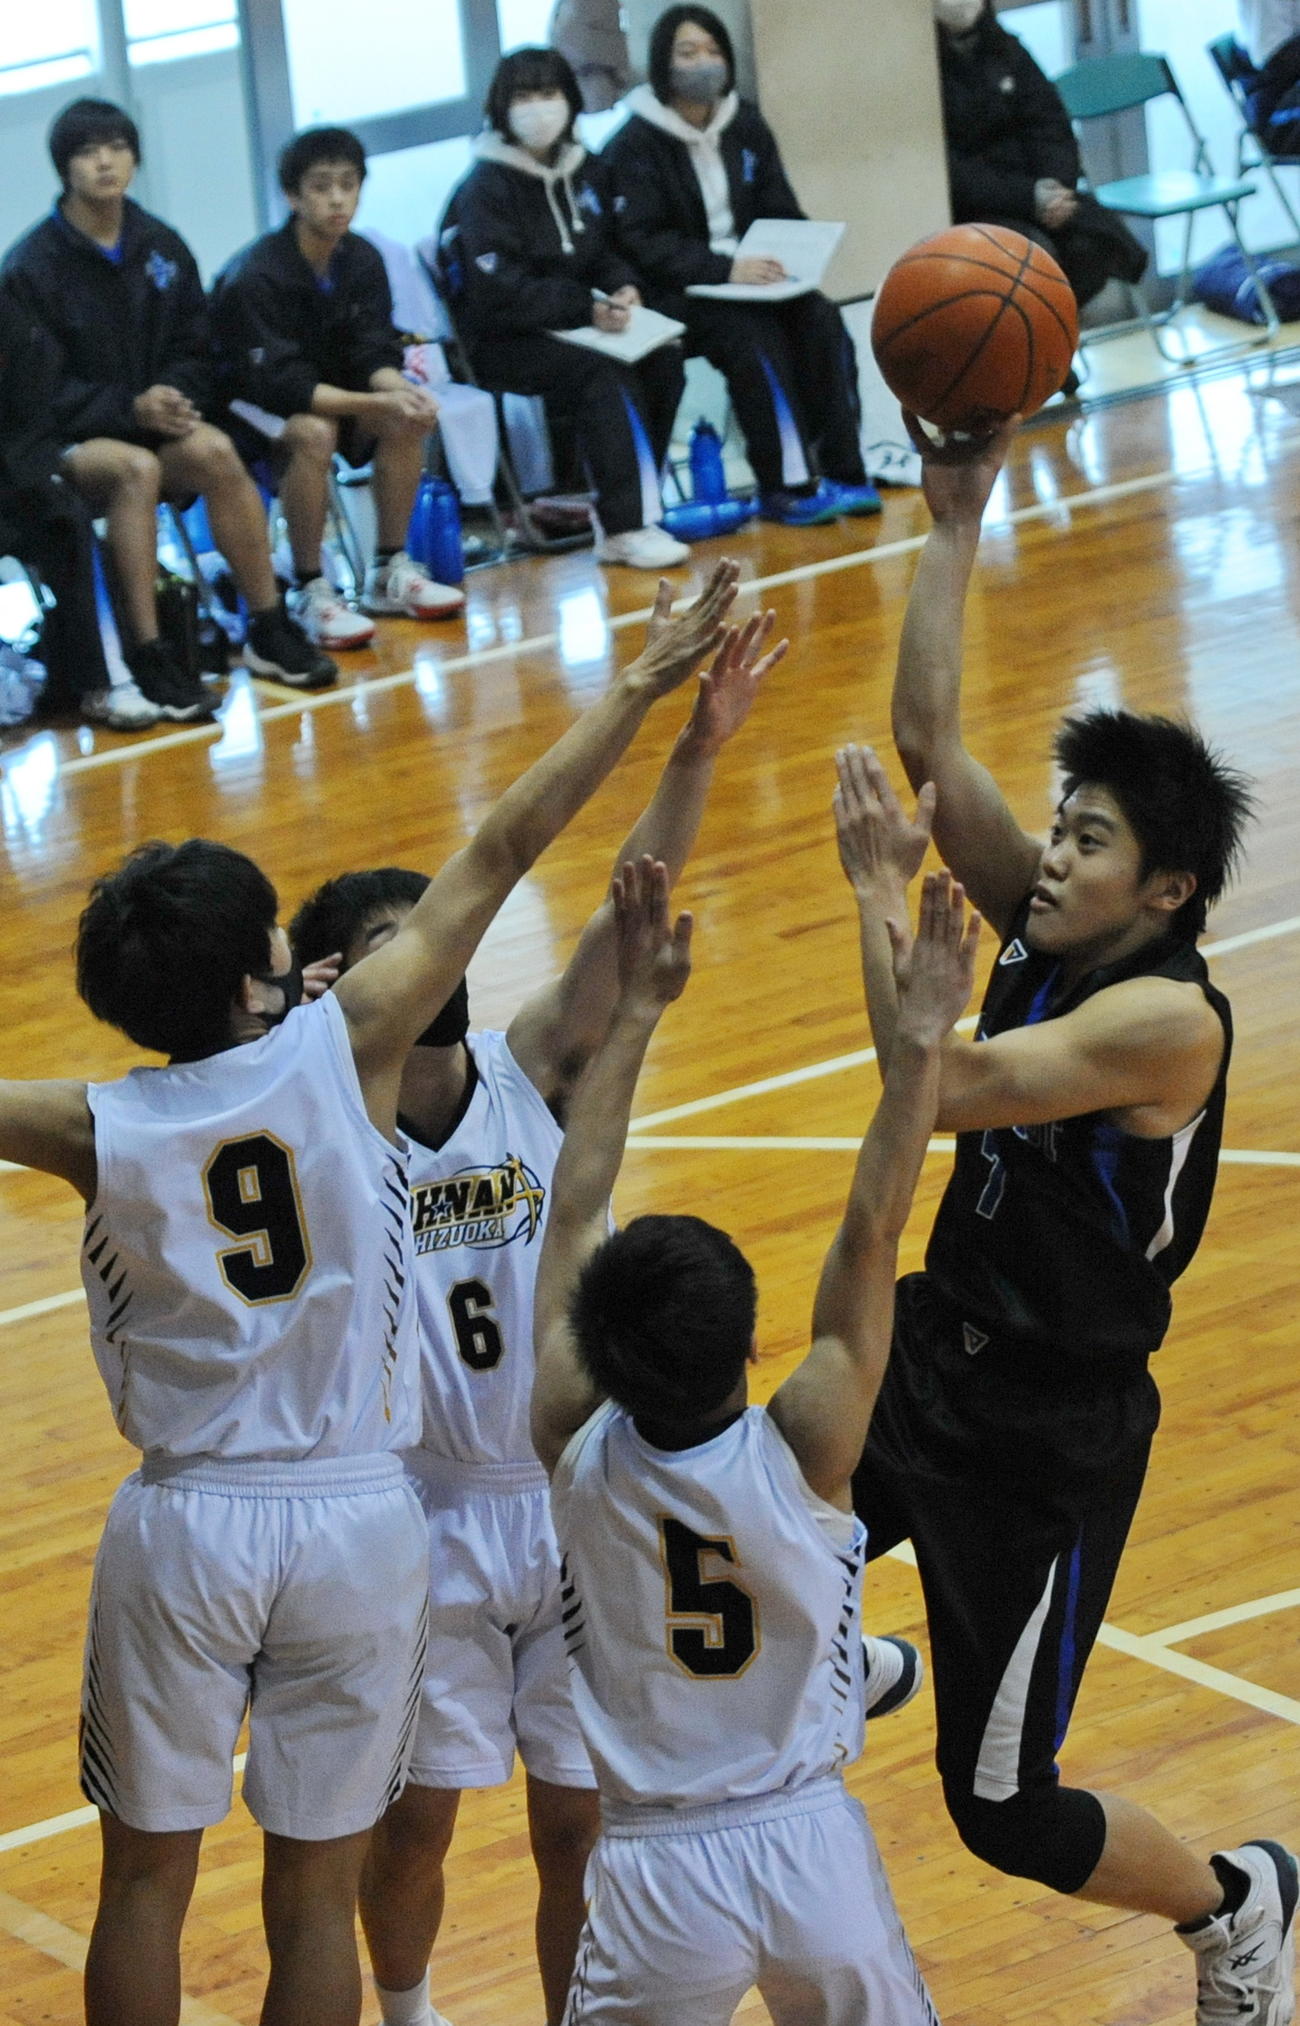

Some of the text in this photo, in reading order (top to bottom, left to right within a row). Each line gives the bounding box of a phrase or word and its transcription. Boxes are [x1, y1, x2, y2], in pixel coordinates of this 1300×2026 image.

[200, 1128, 314, 1308] 9
[447, 1274, 505, 1374] 6
[656, 1511, 763, 1681] 5
